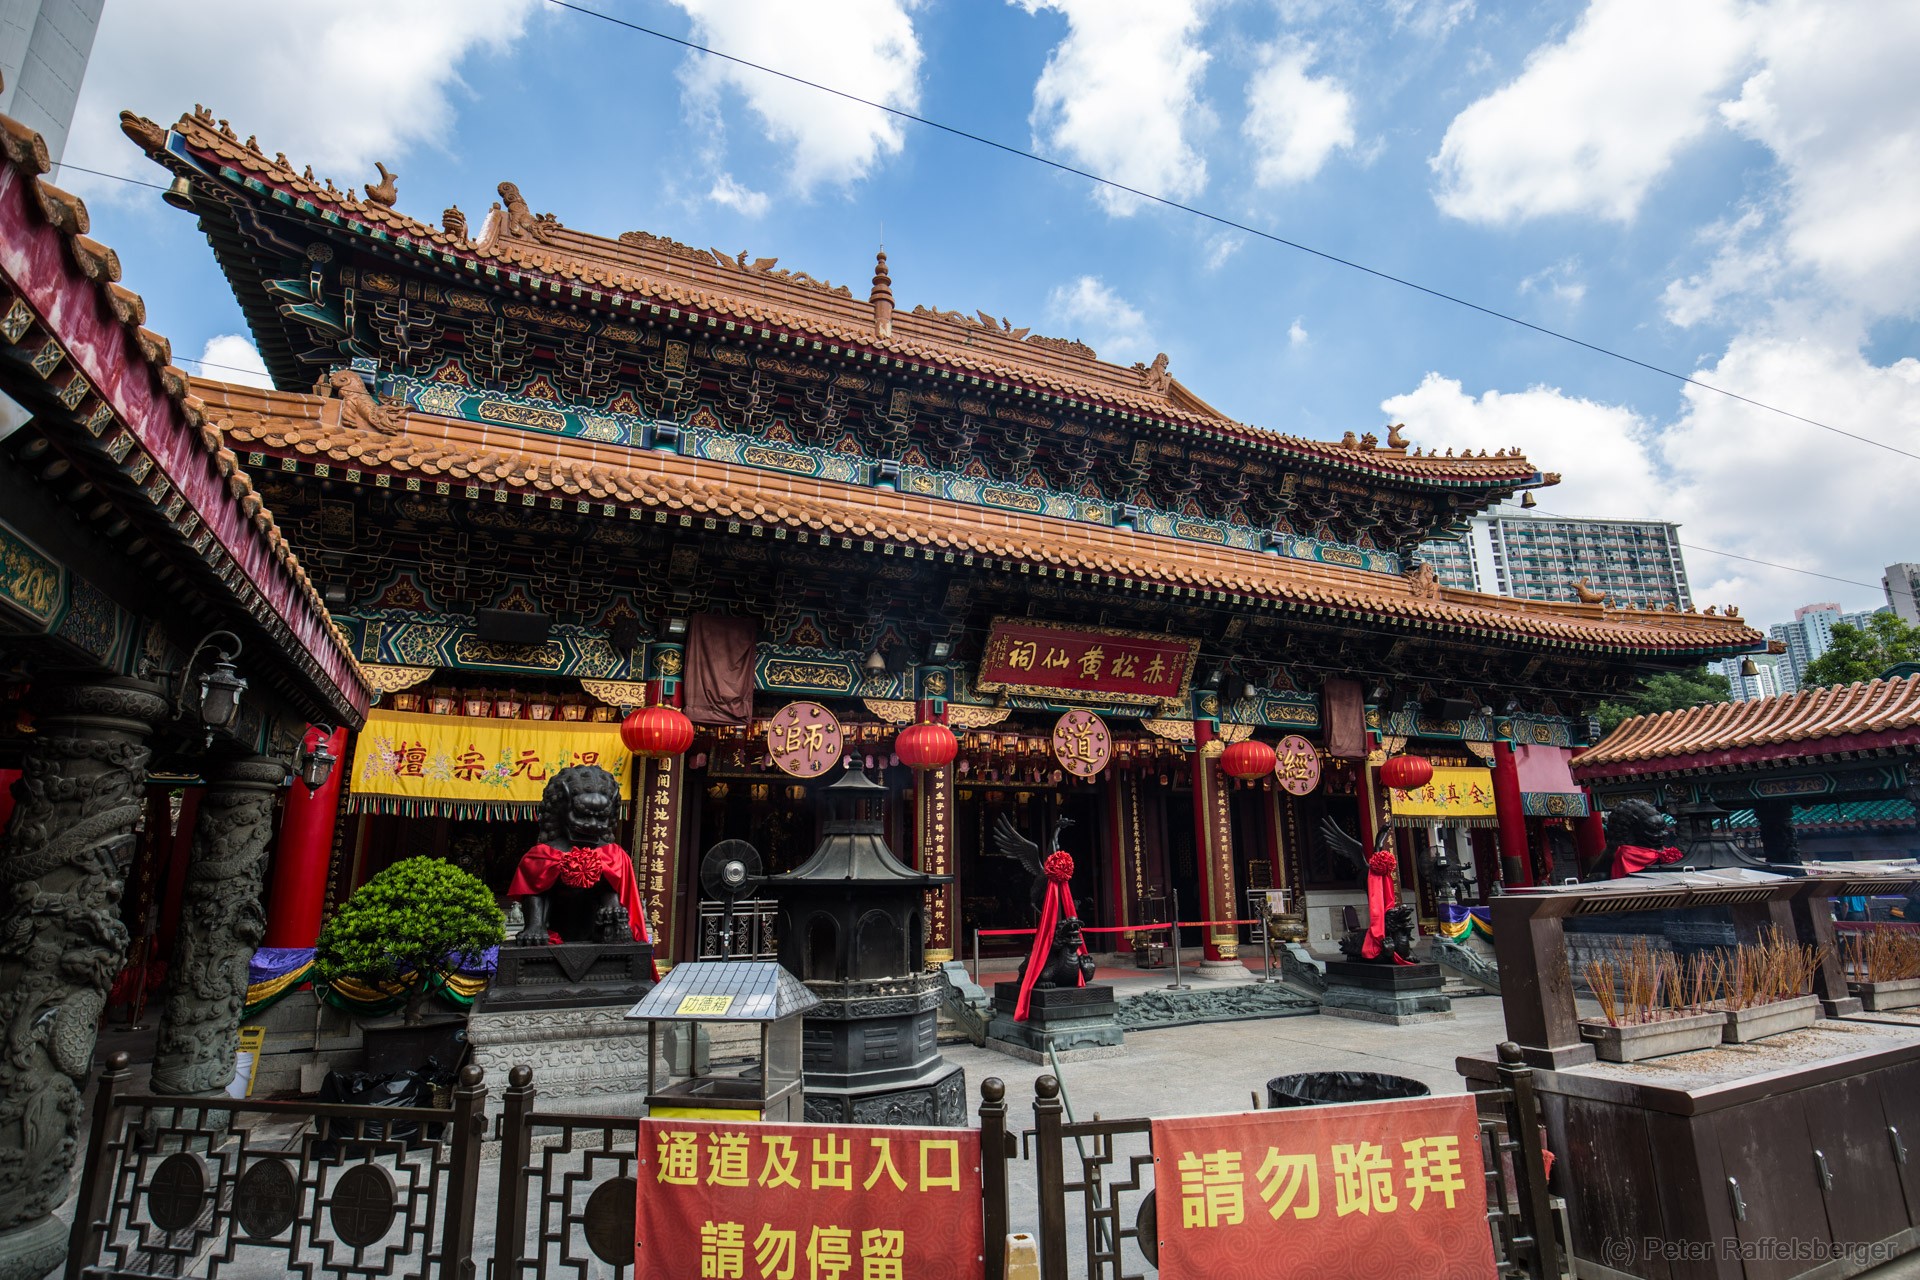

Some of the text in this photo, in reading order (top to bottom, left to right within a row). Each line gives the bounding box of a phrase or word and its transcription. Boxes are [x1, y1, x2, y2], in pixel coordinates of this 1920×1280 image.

[784, 717, 824, 762] 師
[1065, 722, 1099, 764] 道
[1283, 749, 1309, 781] 經
[682, 996, 730, 1012] 功德箱
[657, 1131, 960, 1192] 通道及出入口
[1178, 1135, 1466, 1229] 請勿跪拜
[701, 1220, 905, 1280] 請勿停留
